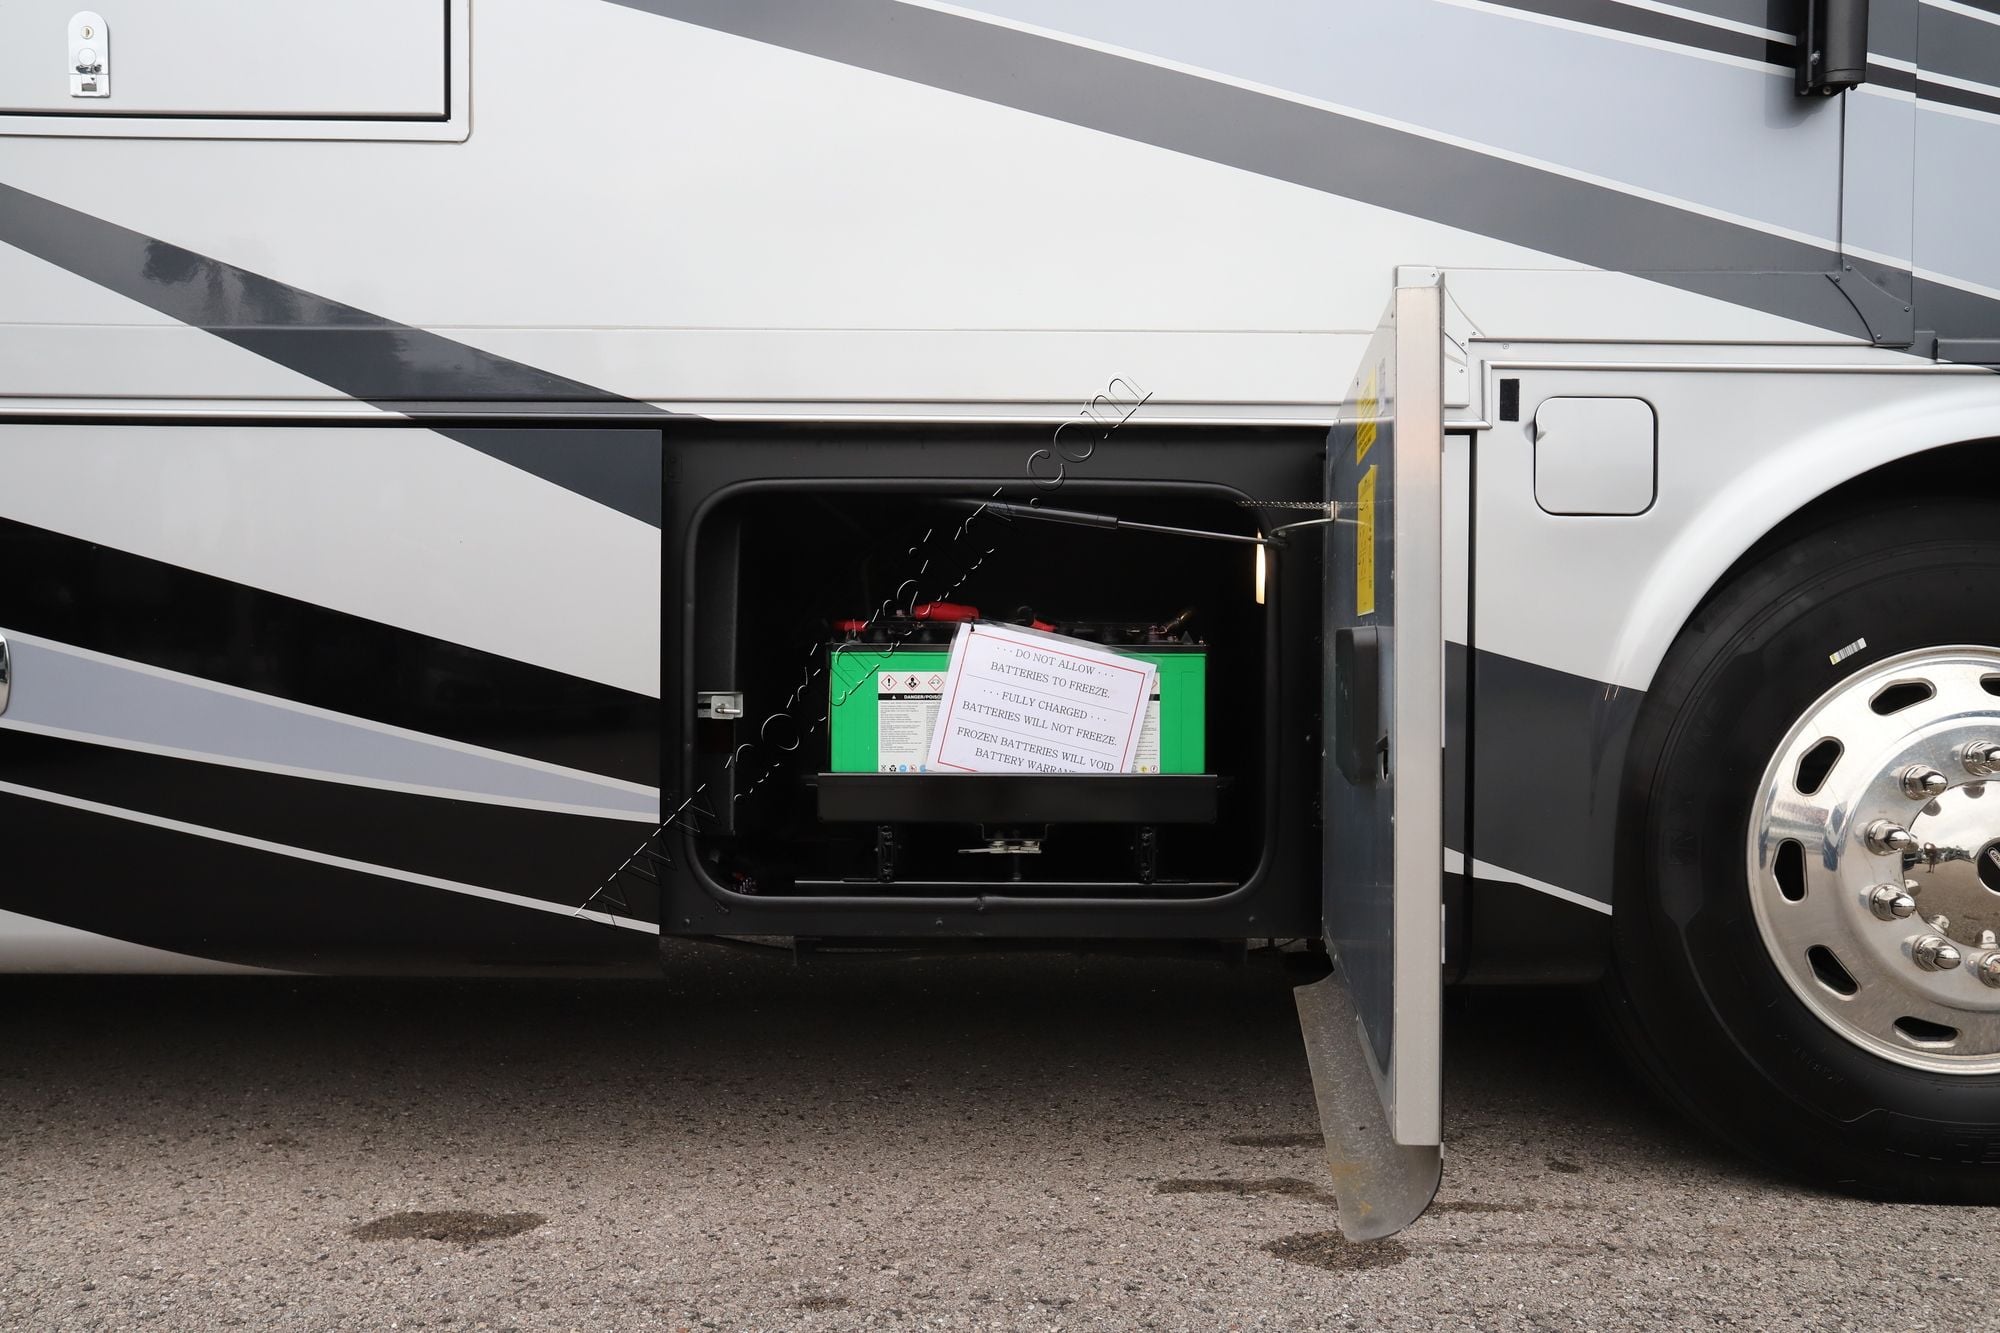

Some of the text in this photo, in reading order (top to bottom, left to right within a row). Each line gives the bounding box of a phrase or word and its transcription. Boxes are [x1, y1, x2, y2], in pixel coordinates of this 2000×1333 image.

[1016, 649, 1096, 675] DO NOT ALLOW
[990, 662, 1110, 698] BATTERIES TO FREEZE.
[1002, 691, 1088, 720] FULLY CHARGED
[962, 701, 1117, 746] BATTERIES WILL NOT FREEZE.
[957, 727, 1114, 772] FROZEN BATTERIES WILL VOID
[975, 748, 1025, 767] BATTERY
